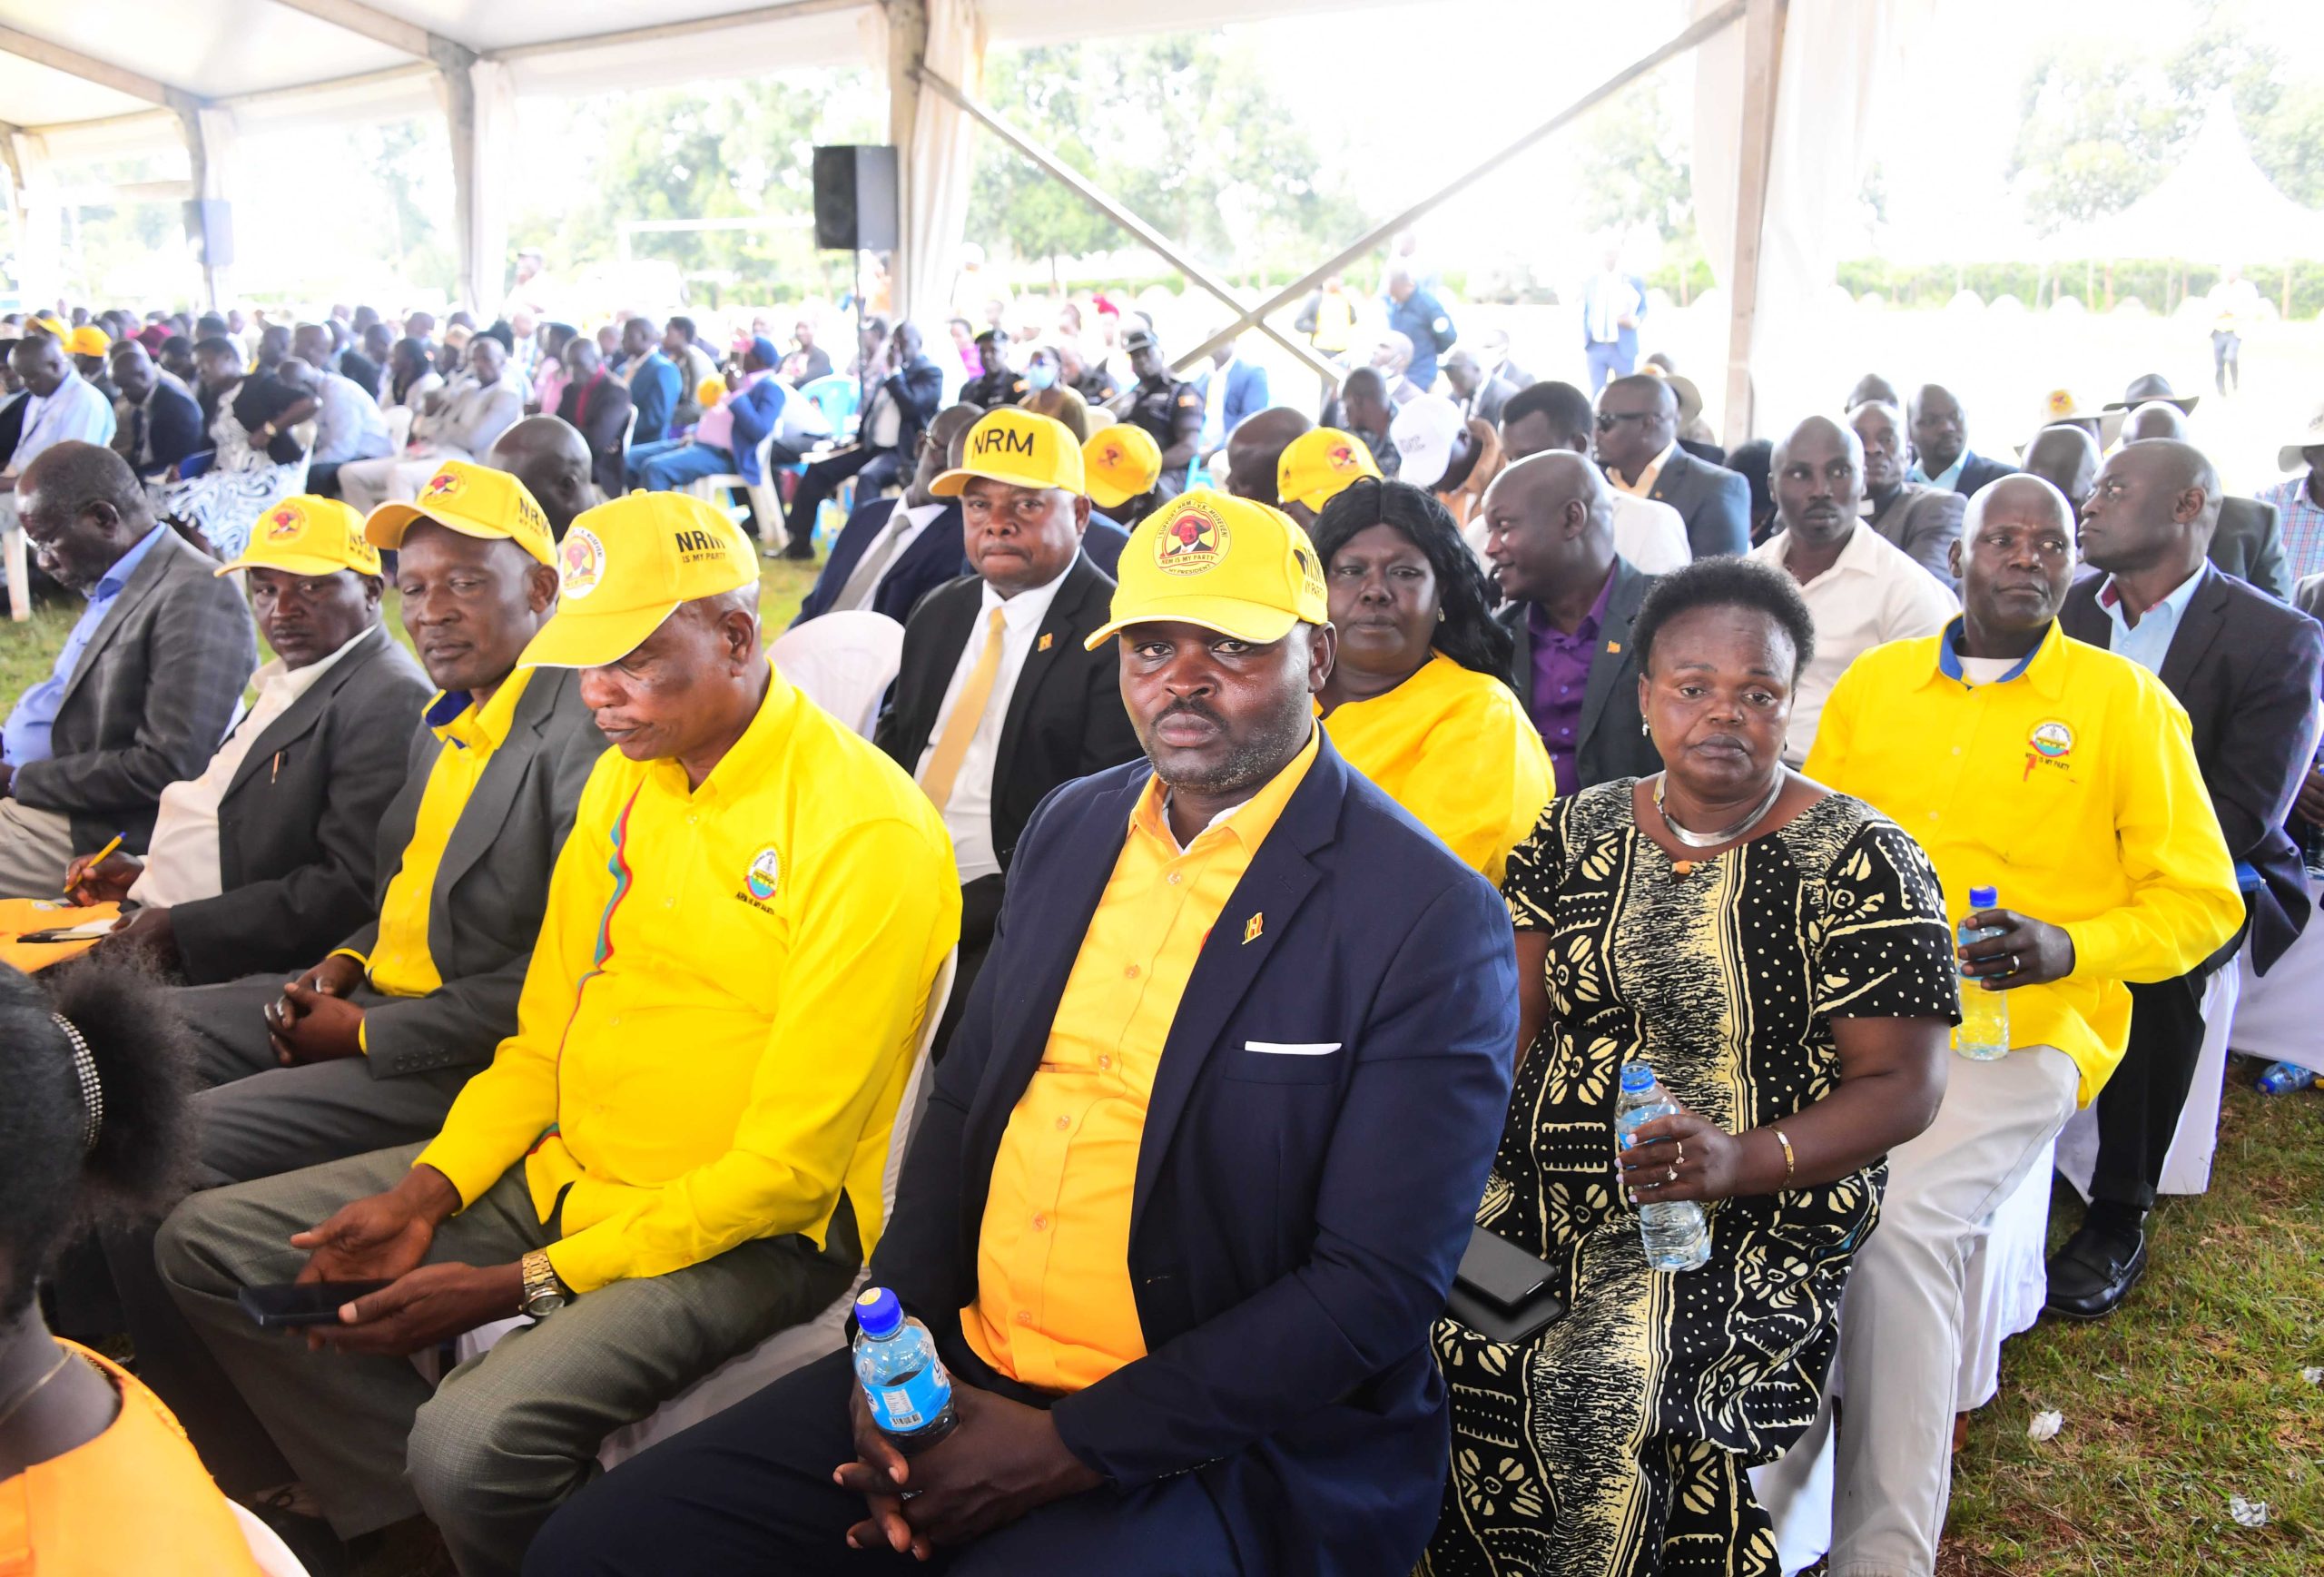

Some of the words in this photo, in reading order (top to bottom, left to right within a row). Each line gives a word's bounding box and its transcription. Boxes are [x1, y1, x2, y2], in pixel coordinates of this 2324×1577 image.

[972, 429, 1034, 457] NRM
[1158, 509, 1177, 536] SUPPORT
[1209, 509, 1228, 537] MUSEVENI
[693, 553, 704, 562] MY
[1177, 564, 1211, 574] PRESIDENT
